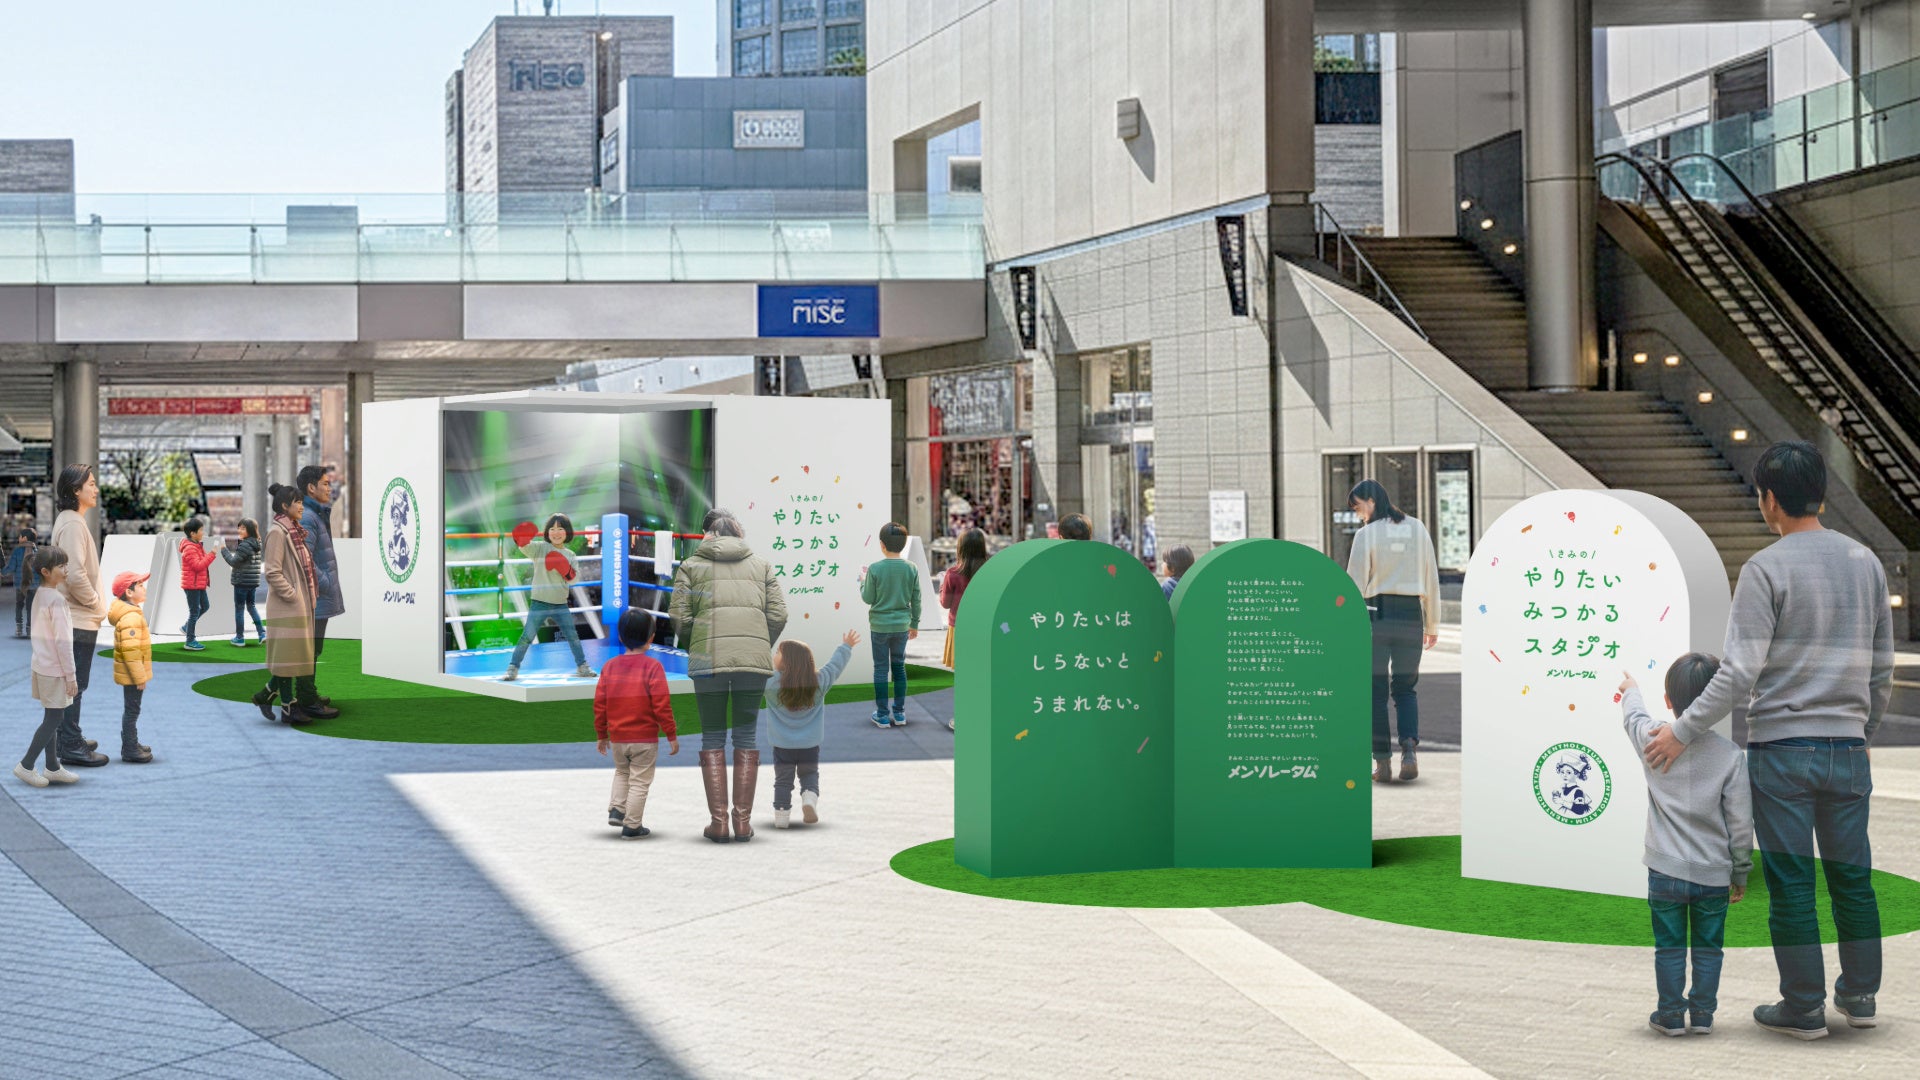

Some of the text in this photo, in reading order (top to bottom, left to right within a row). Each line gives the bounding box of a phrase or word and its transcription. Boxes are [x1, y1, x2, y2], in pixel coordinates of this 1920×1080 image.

[773, 508, 840, 525] やりたい
[772, 535, 839, 551] みつかる
[774, 559, 840, 577] スタジオ
[1524, 566, 1621, 588] やりたい
[1030, 610, 1132, 629] やりたいは
[1523, 601, 1620, 622] みつかる
[1524, 635, 1621, 659] スタジオ
[1033, 652, 1129, 670] しらないと
[1033, 694, 1140, 713] うまれない。
[1541, 743, 1604, 765] MENTHOLATUM
